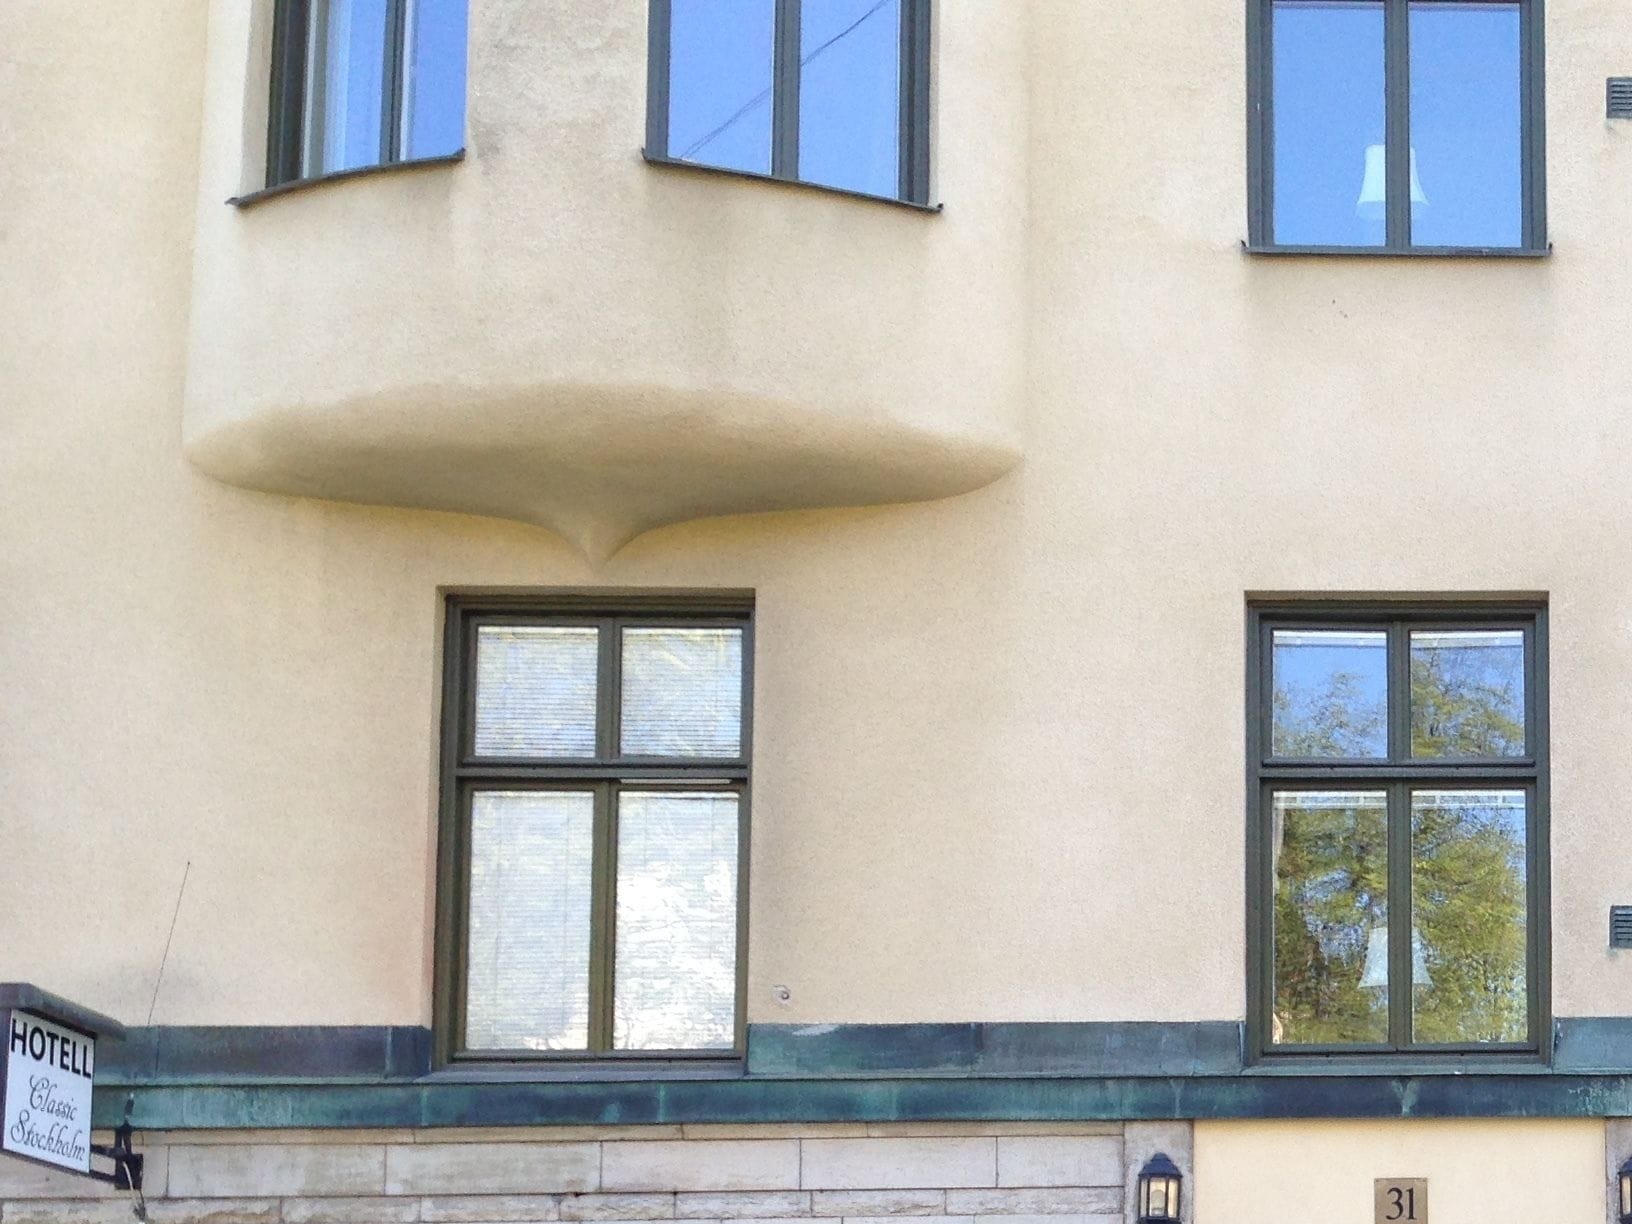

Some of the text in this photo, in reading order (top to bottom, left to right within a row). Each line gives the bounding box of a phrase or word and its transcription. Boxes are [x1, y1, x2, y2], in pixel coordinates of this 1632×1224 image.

[11, 1018, 92, 1080] HOTELL
[29, 1074, 78, 1121] Classic
[10, 1109, 86, 1161] Stockholm
[1385, 1187, 1418, 1221] 31
